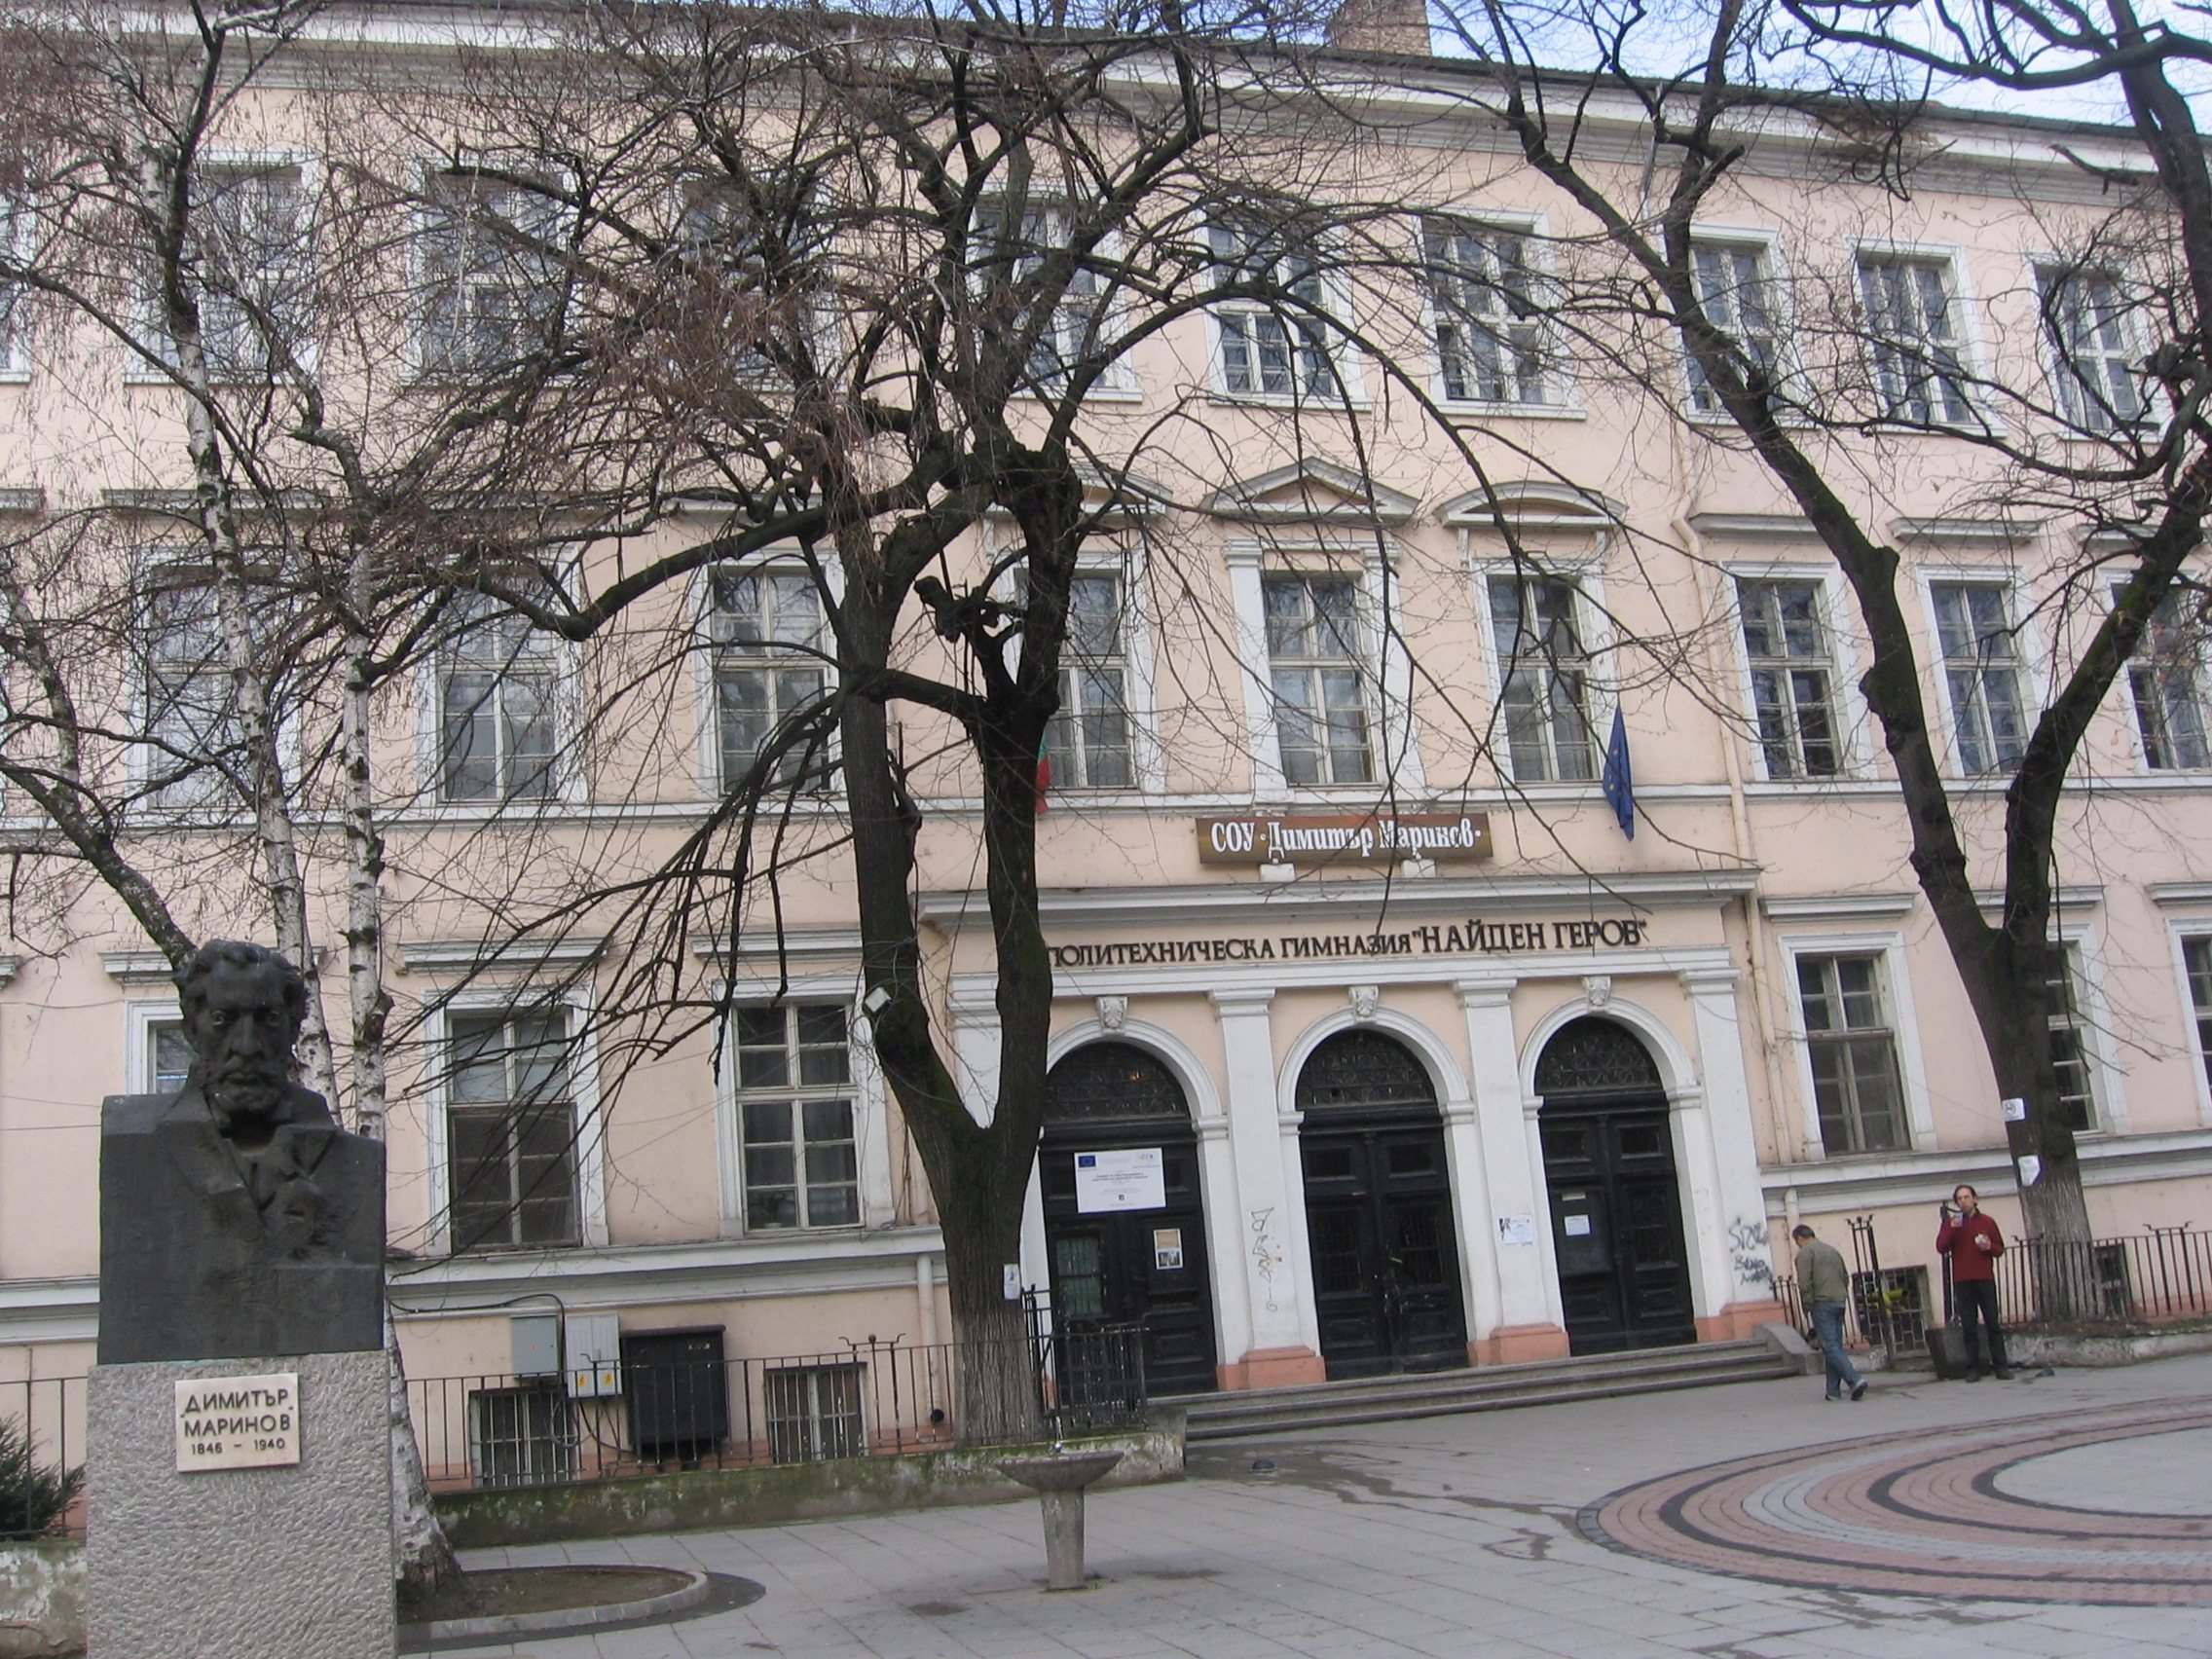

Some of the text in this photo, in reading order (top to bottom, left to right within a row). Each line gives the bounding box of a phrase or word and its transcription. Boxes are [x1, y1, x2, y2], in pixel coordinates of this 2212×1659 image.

[1211, 821, 1255, 853] СОУ
[1048, 938, 1274, 967] ПОЛИТЕХНИЧЕСКА
[1280, 932, 1412, 958] ГИМНАЗИЯ
[185, 1388, 288, 1414] ДИМИТЪР
[184, 1414, 290, 1437] МАРИНОВ
[192, 1442, 223, 1455] 1846
[254, 1438, 285, 1451] 1940
